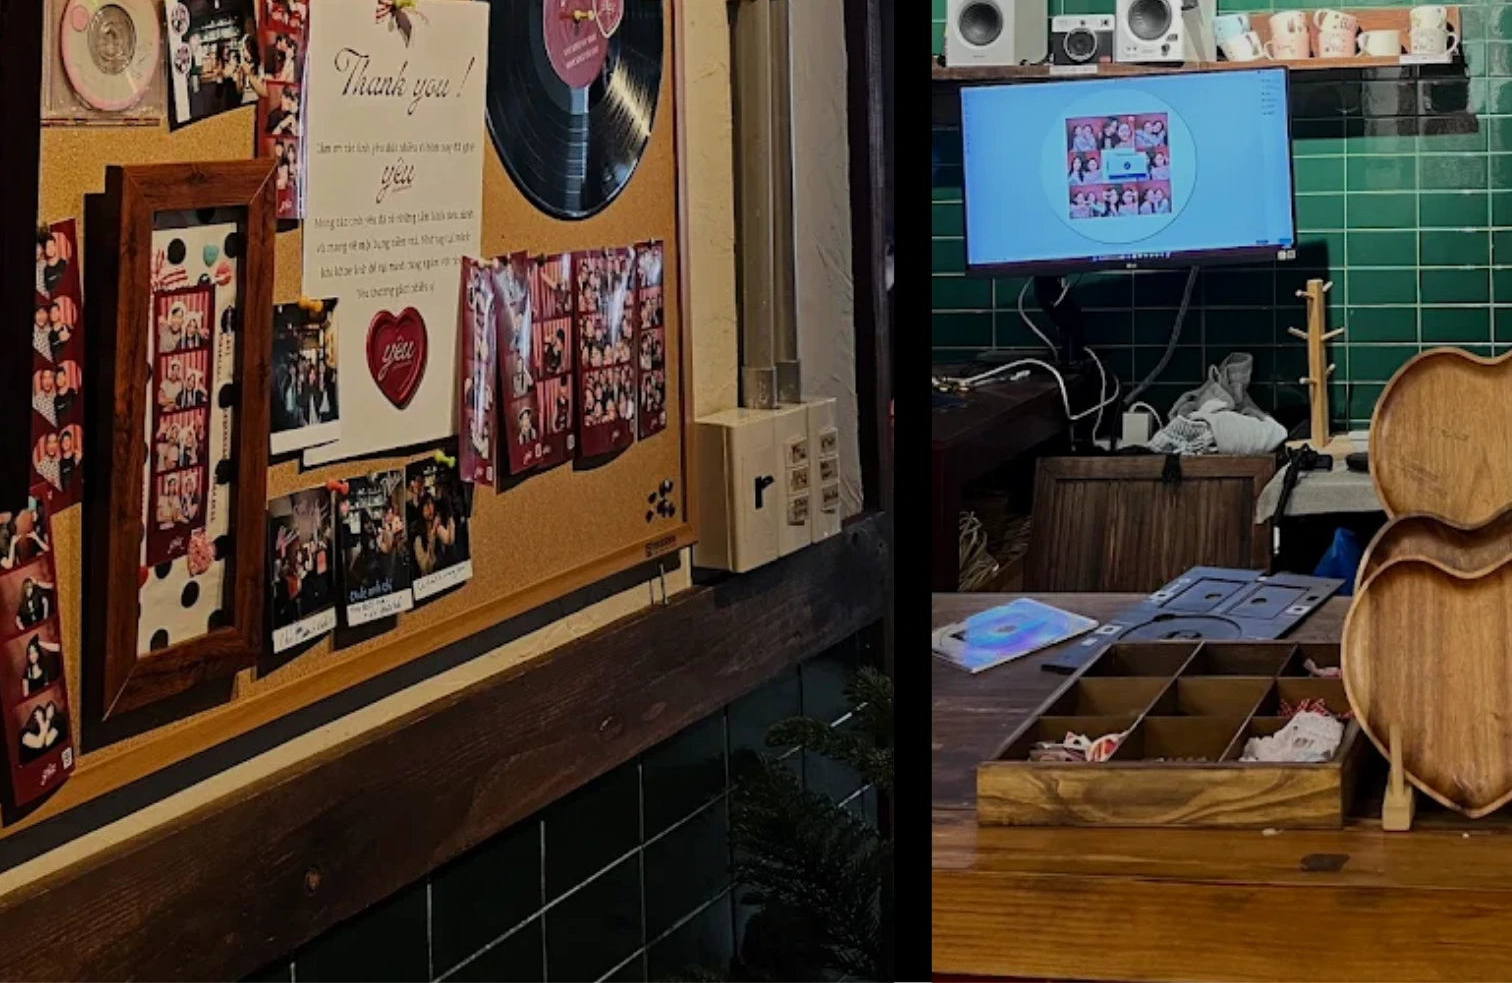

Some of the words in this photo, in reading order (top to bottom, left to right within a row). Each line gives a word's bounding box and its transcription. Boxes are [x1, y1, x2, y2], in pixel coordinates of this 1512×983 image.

[334, 47, 408, 97] Thank
[406, 77, 450, 115] you
[376, 156, 415, 204] yêu
[378, 336, 415, 381] yêu
